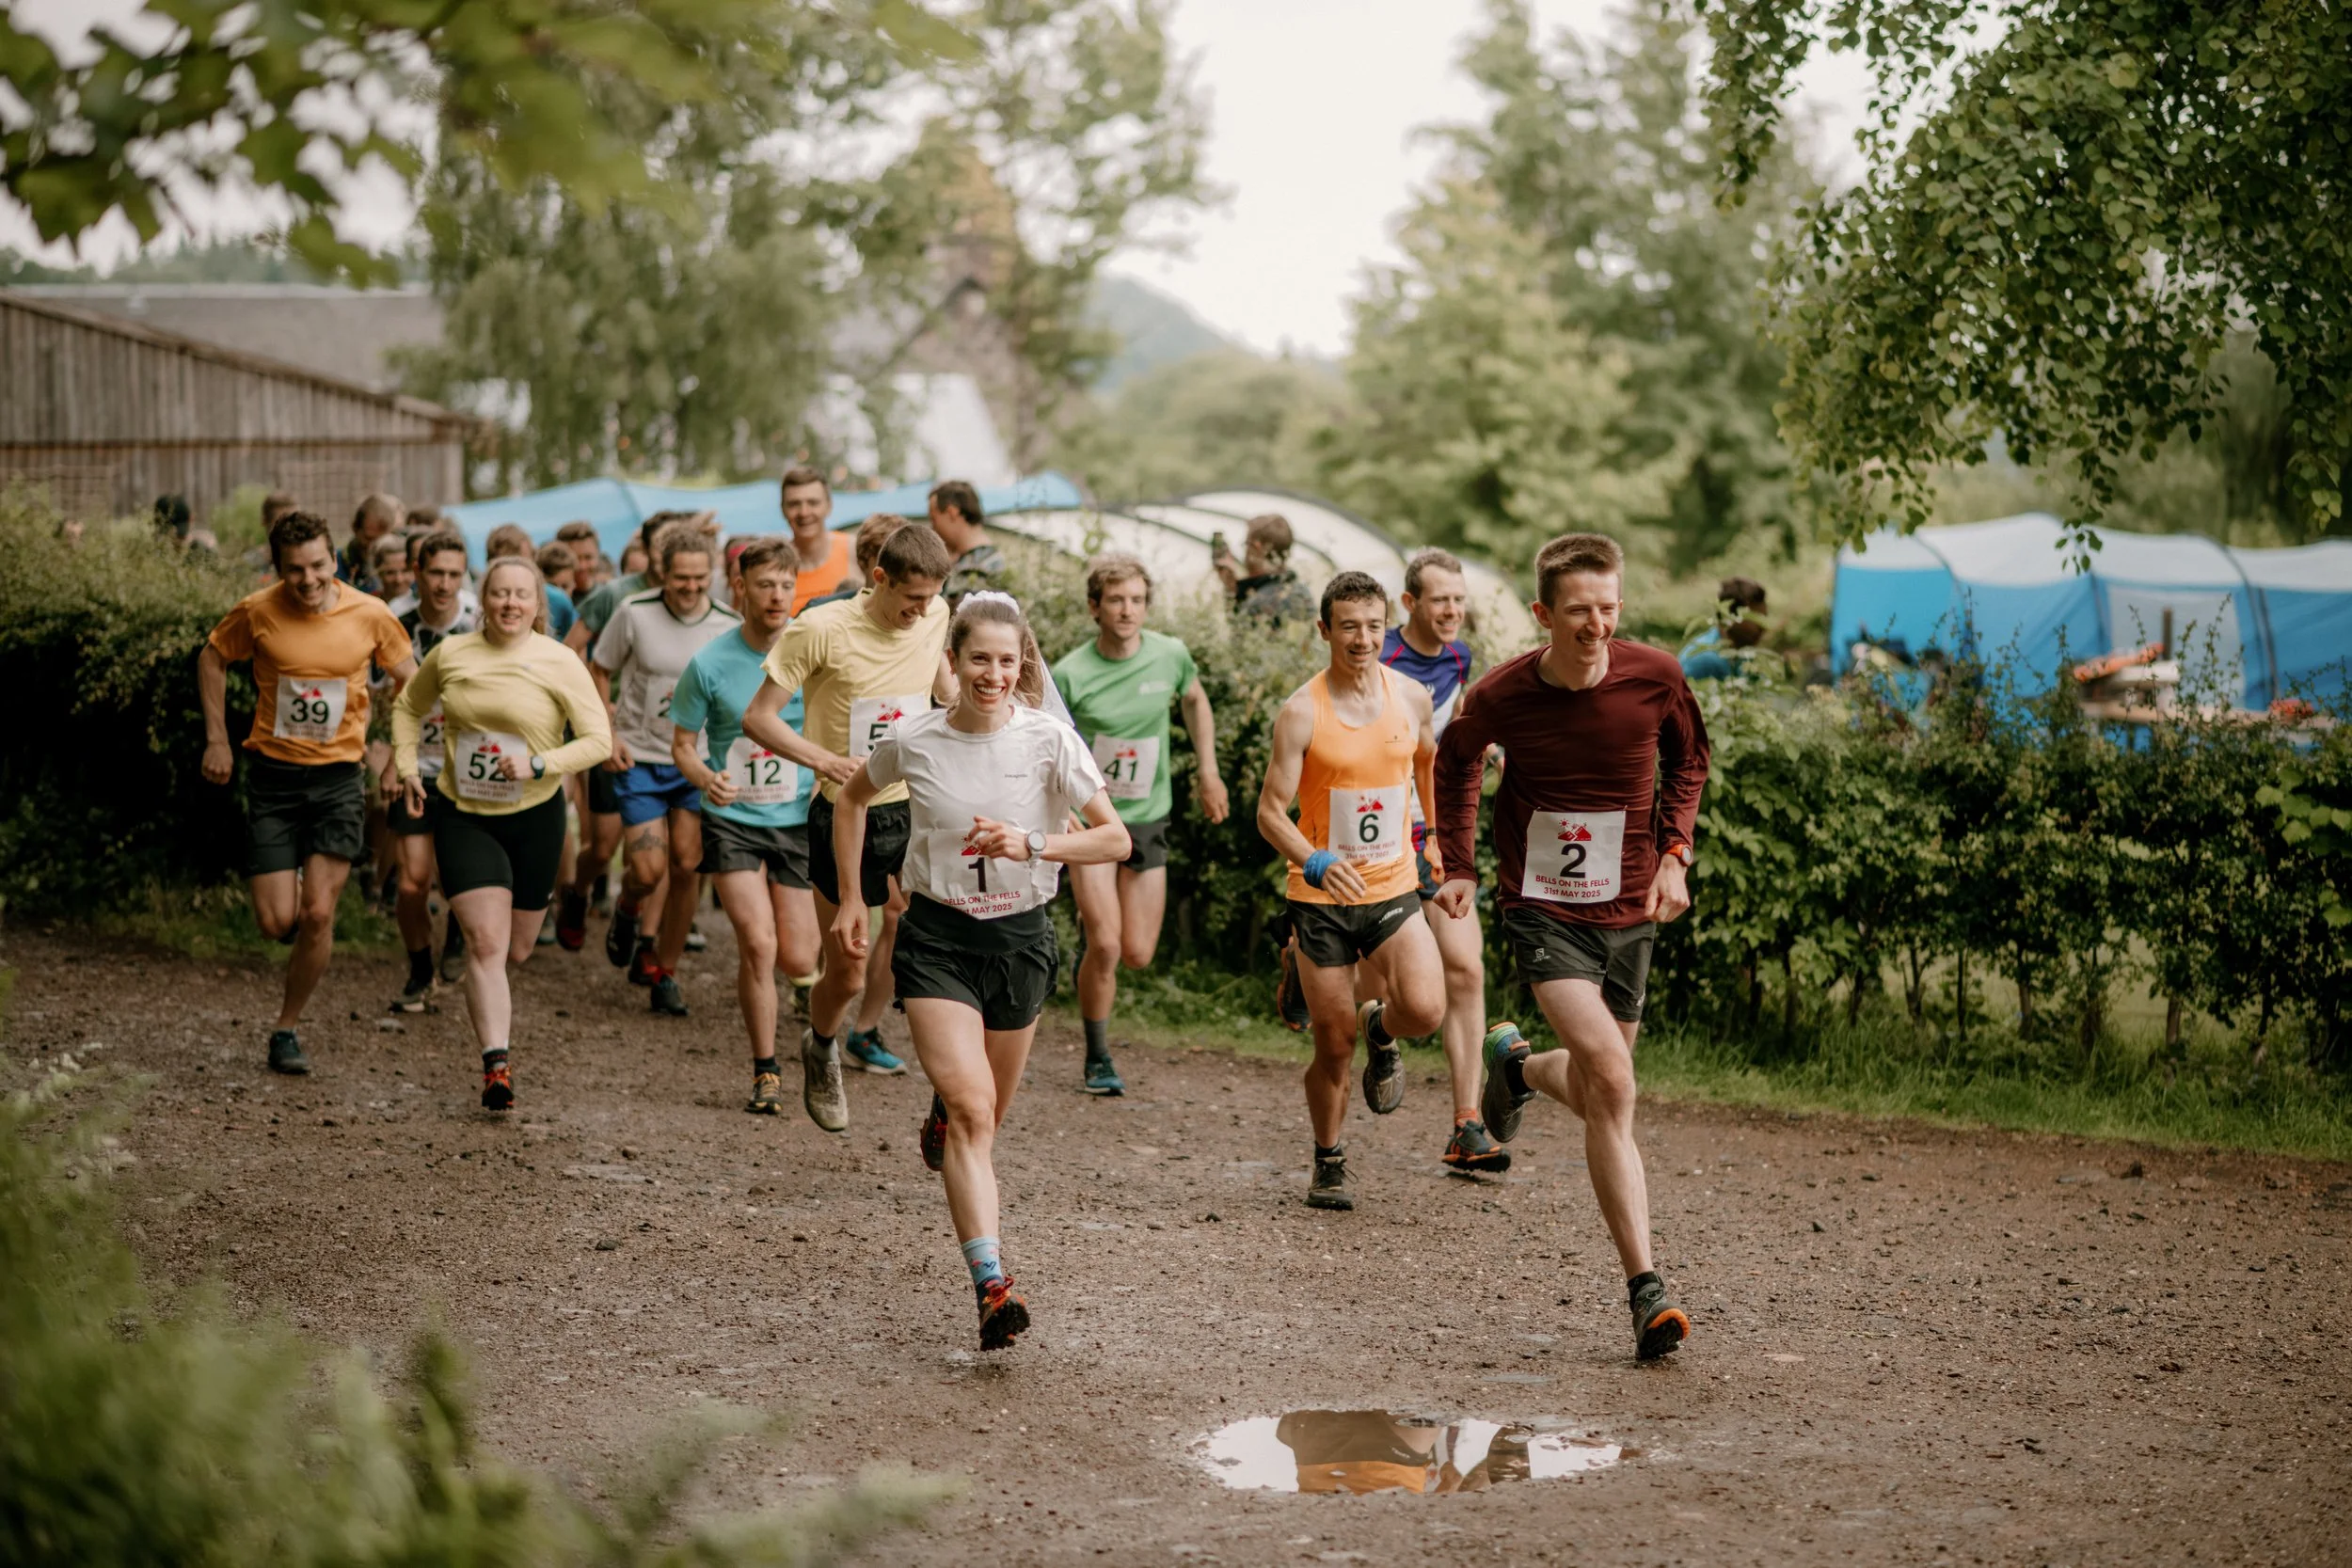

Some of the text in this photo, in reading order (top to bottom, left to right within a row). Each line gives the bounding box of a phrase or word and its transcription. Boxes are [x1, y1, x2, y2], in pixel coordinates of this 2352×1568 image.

[290, 698, 329, 724] 39
[469, 752, 507, 783] 52
[744, 759, 782, 786] 12
[1104, 759, 1138, 782] 41
[1359, 813, 1379, 843] 6
[1559, 843, 1586, 879] 2
[968, 857, 987, 893] 1
[1535, 875, 1557, 885] BELLS
[1558, 879, 1571, 888] ON
[1590, 878, 1610, 887] FELLS
[983, 894, 998, 902] THE
[999, 891, 1021, 900] FELLS
[1543, 887, 1601, 898] 31st MAY 2025
[972, 906, 991, 914] MAY
[993, 903, 1012, 912] 2025
